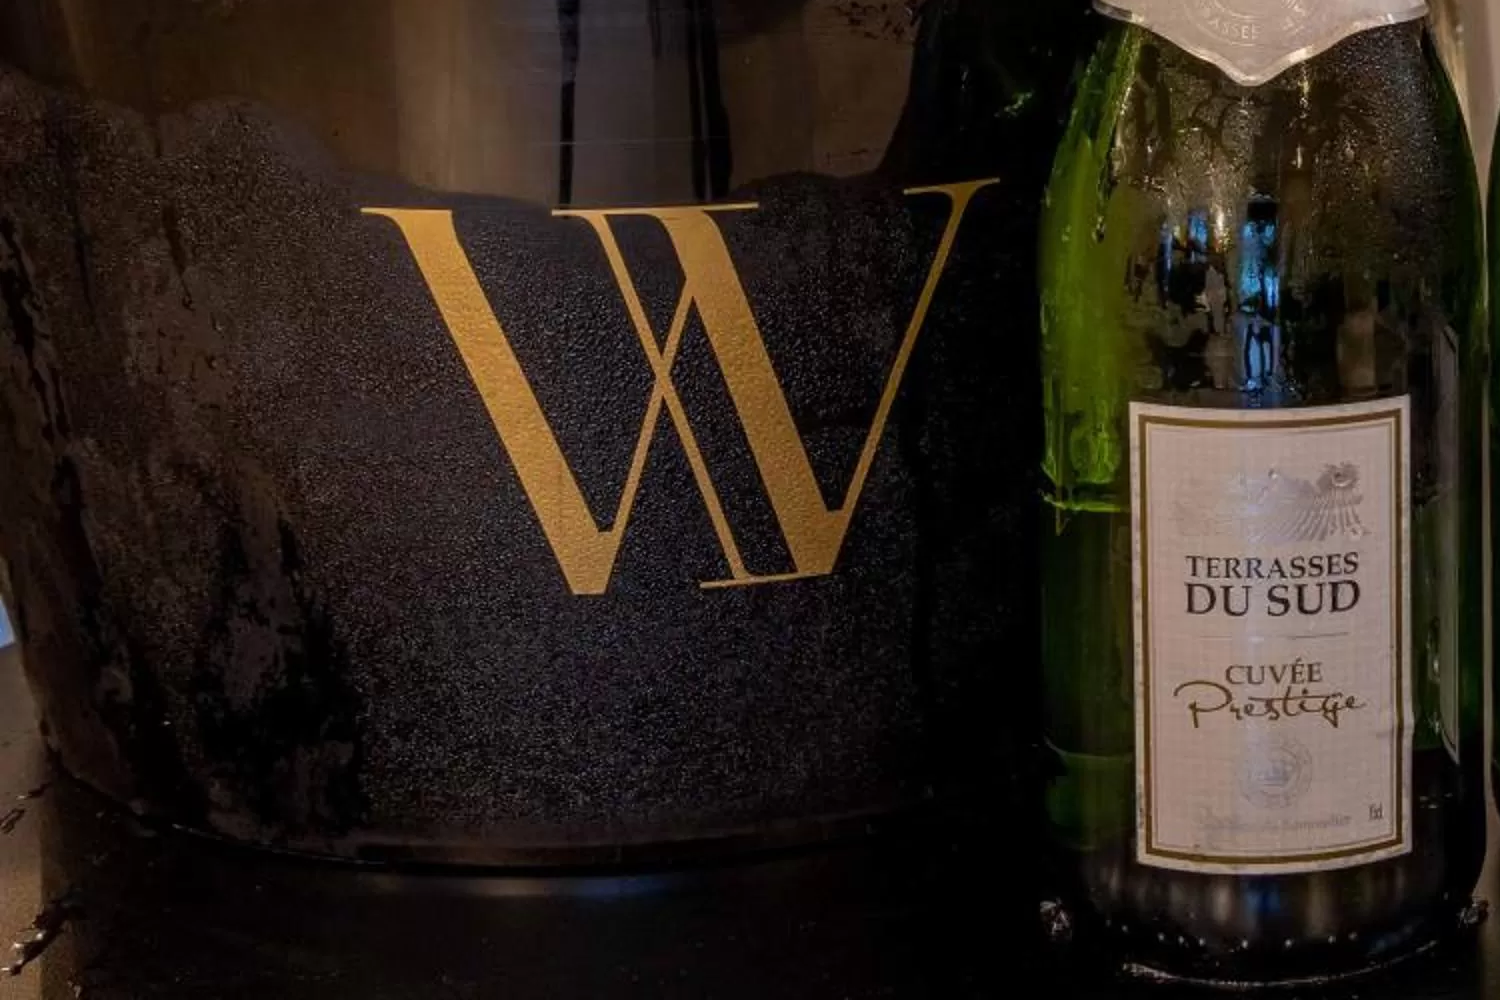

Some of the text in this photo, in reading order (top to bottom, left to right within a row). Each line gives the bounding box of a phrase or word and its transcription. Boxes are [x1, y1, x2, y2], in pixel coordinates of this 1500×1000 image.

[1185, 551, 1360, 580] TERRASSES
[1185, 579, 1361, 617] DU SUD
[1225, 657, 1323, 686] CUVÉE
[1173, 679, 1367, 729] Prestige
